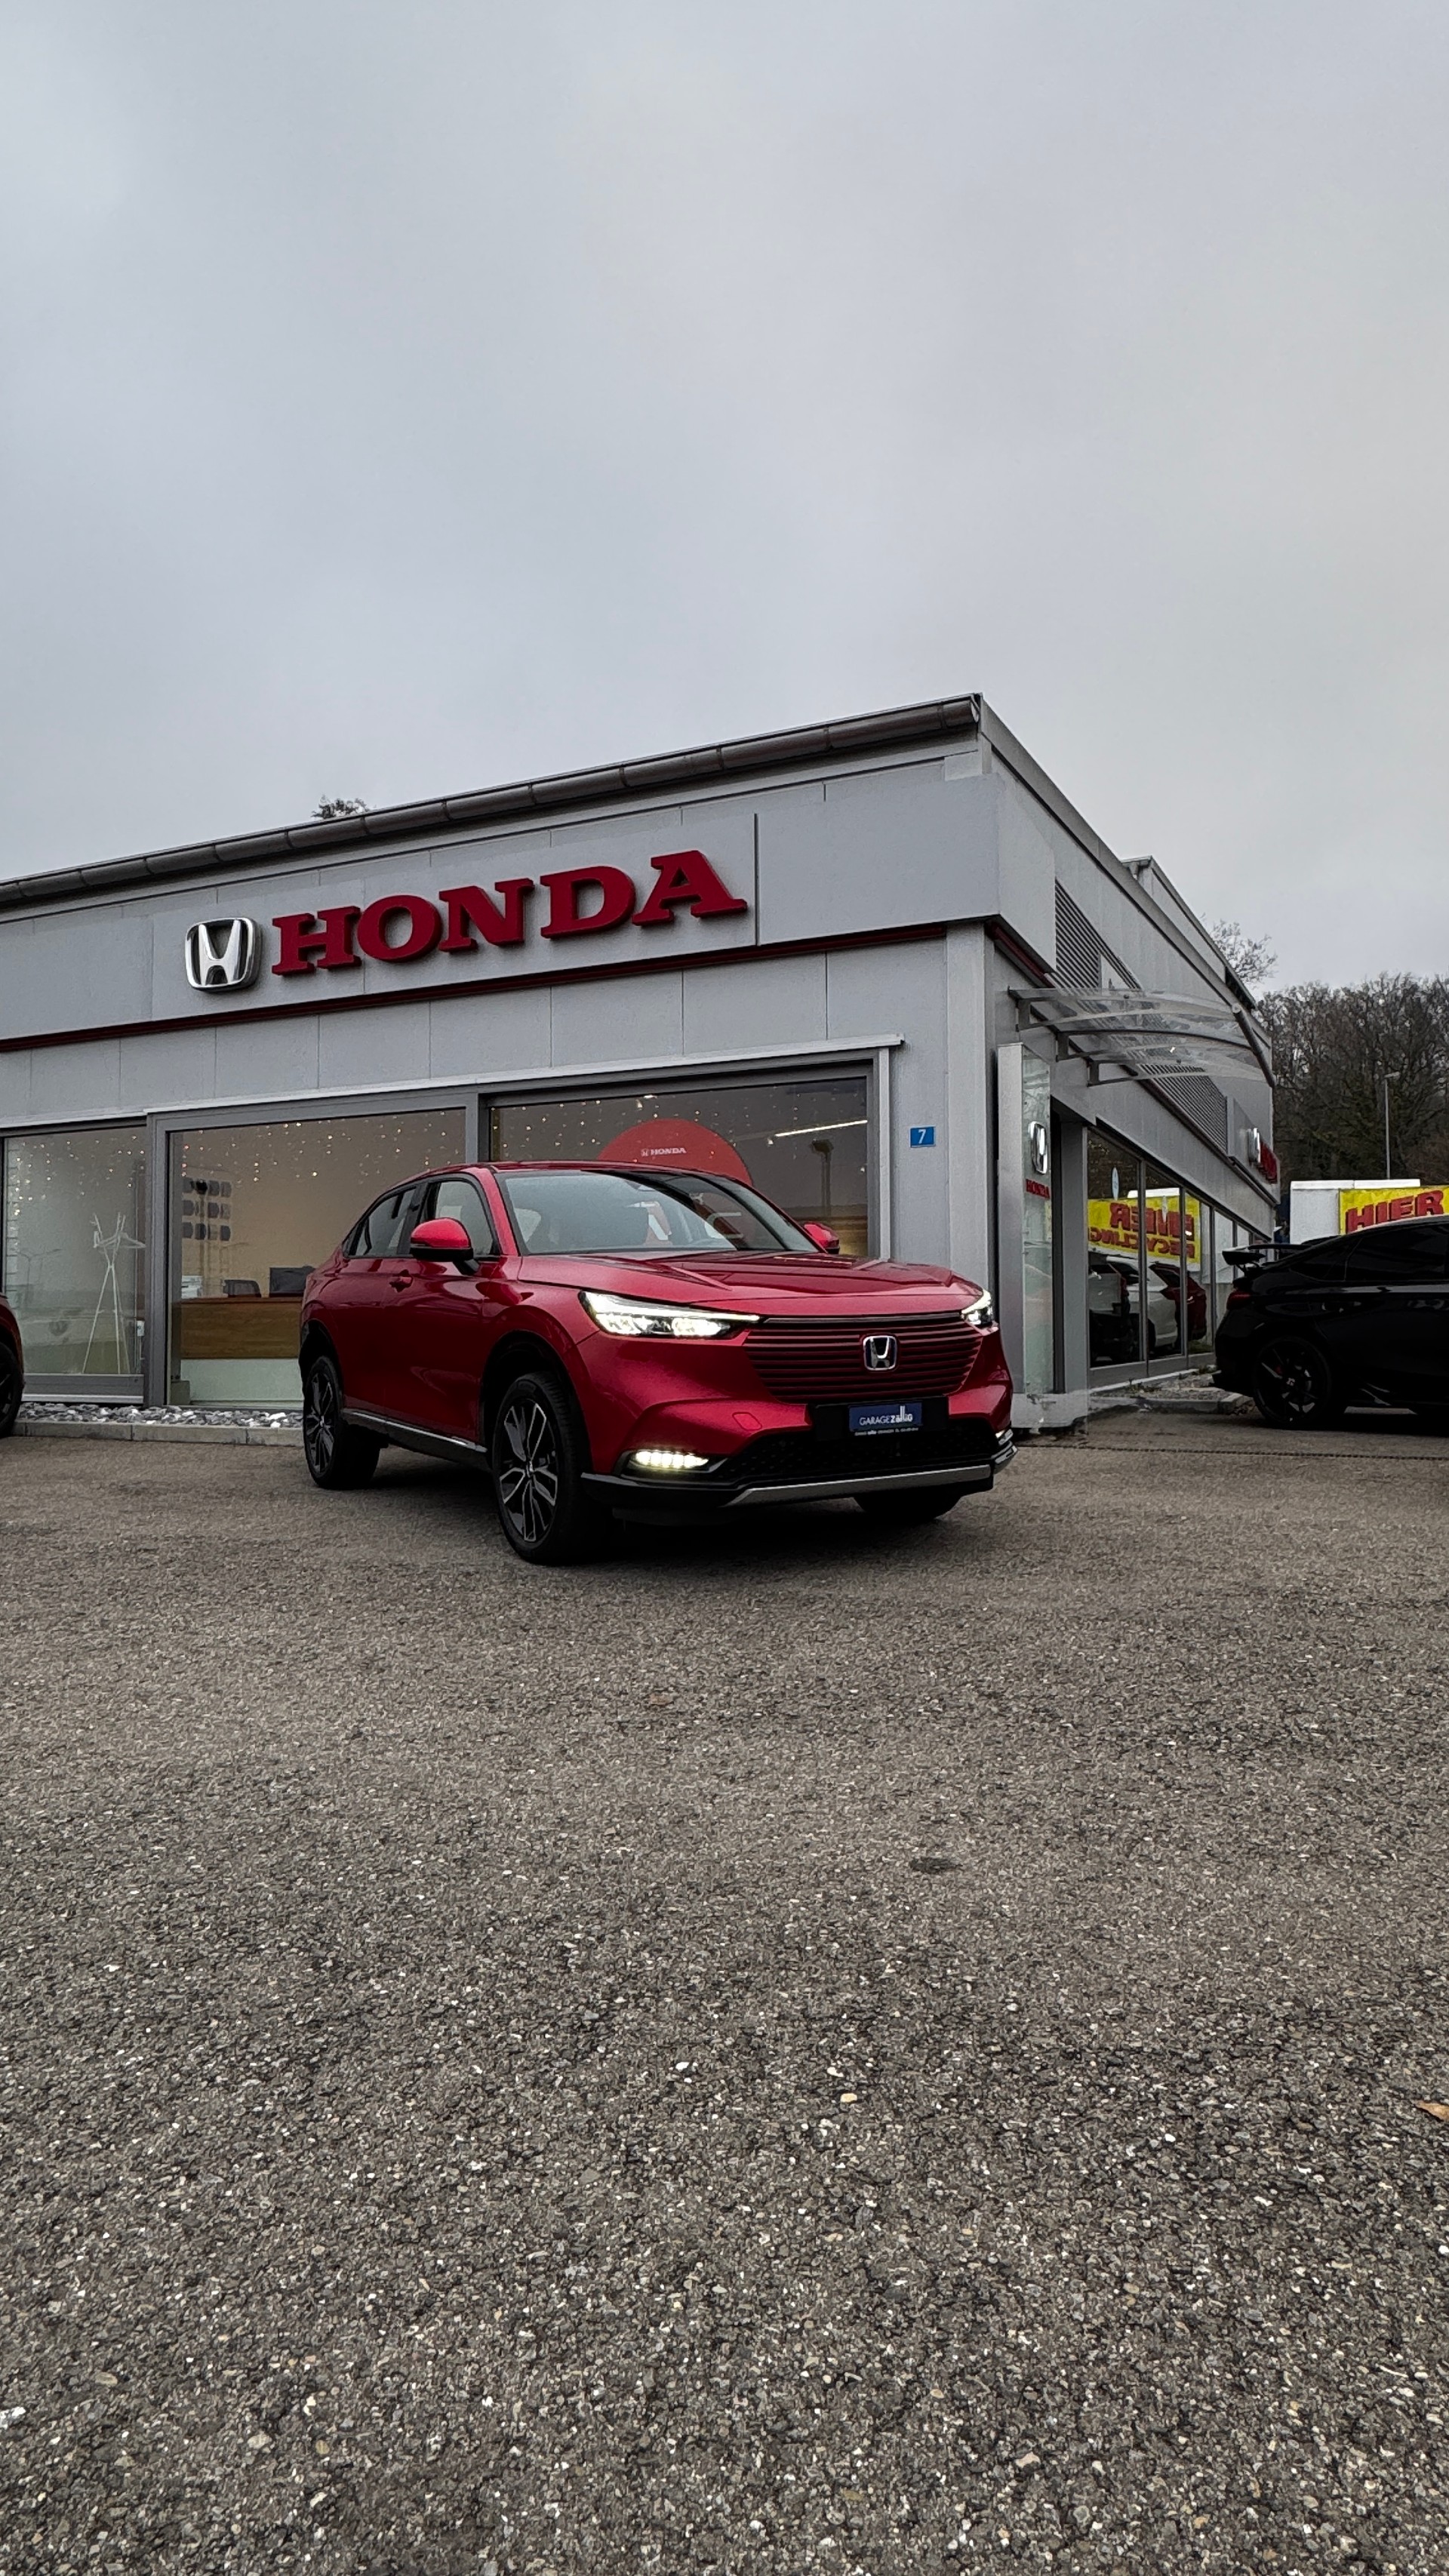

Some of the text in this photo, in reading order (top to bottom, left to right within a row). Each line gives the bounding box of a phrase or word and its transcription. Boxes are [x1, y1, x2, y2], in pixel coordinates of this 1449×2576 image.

[272, 850, 747, 975] HONDA
[918, 1129, 926, 1144] 7
[1346, 1190, 1444, 1234] HIER
